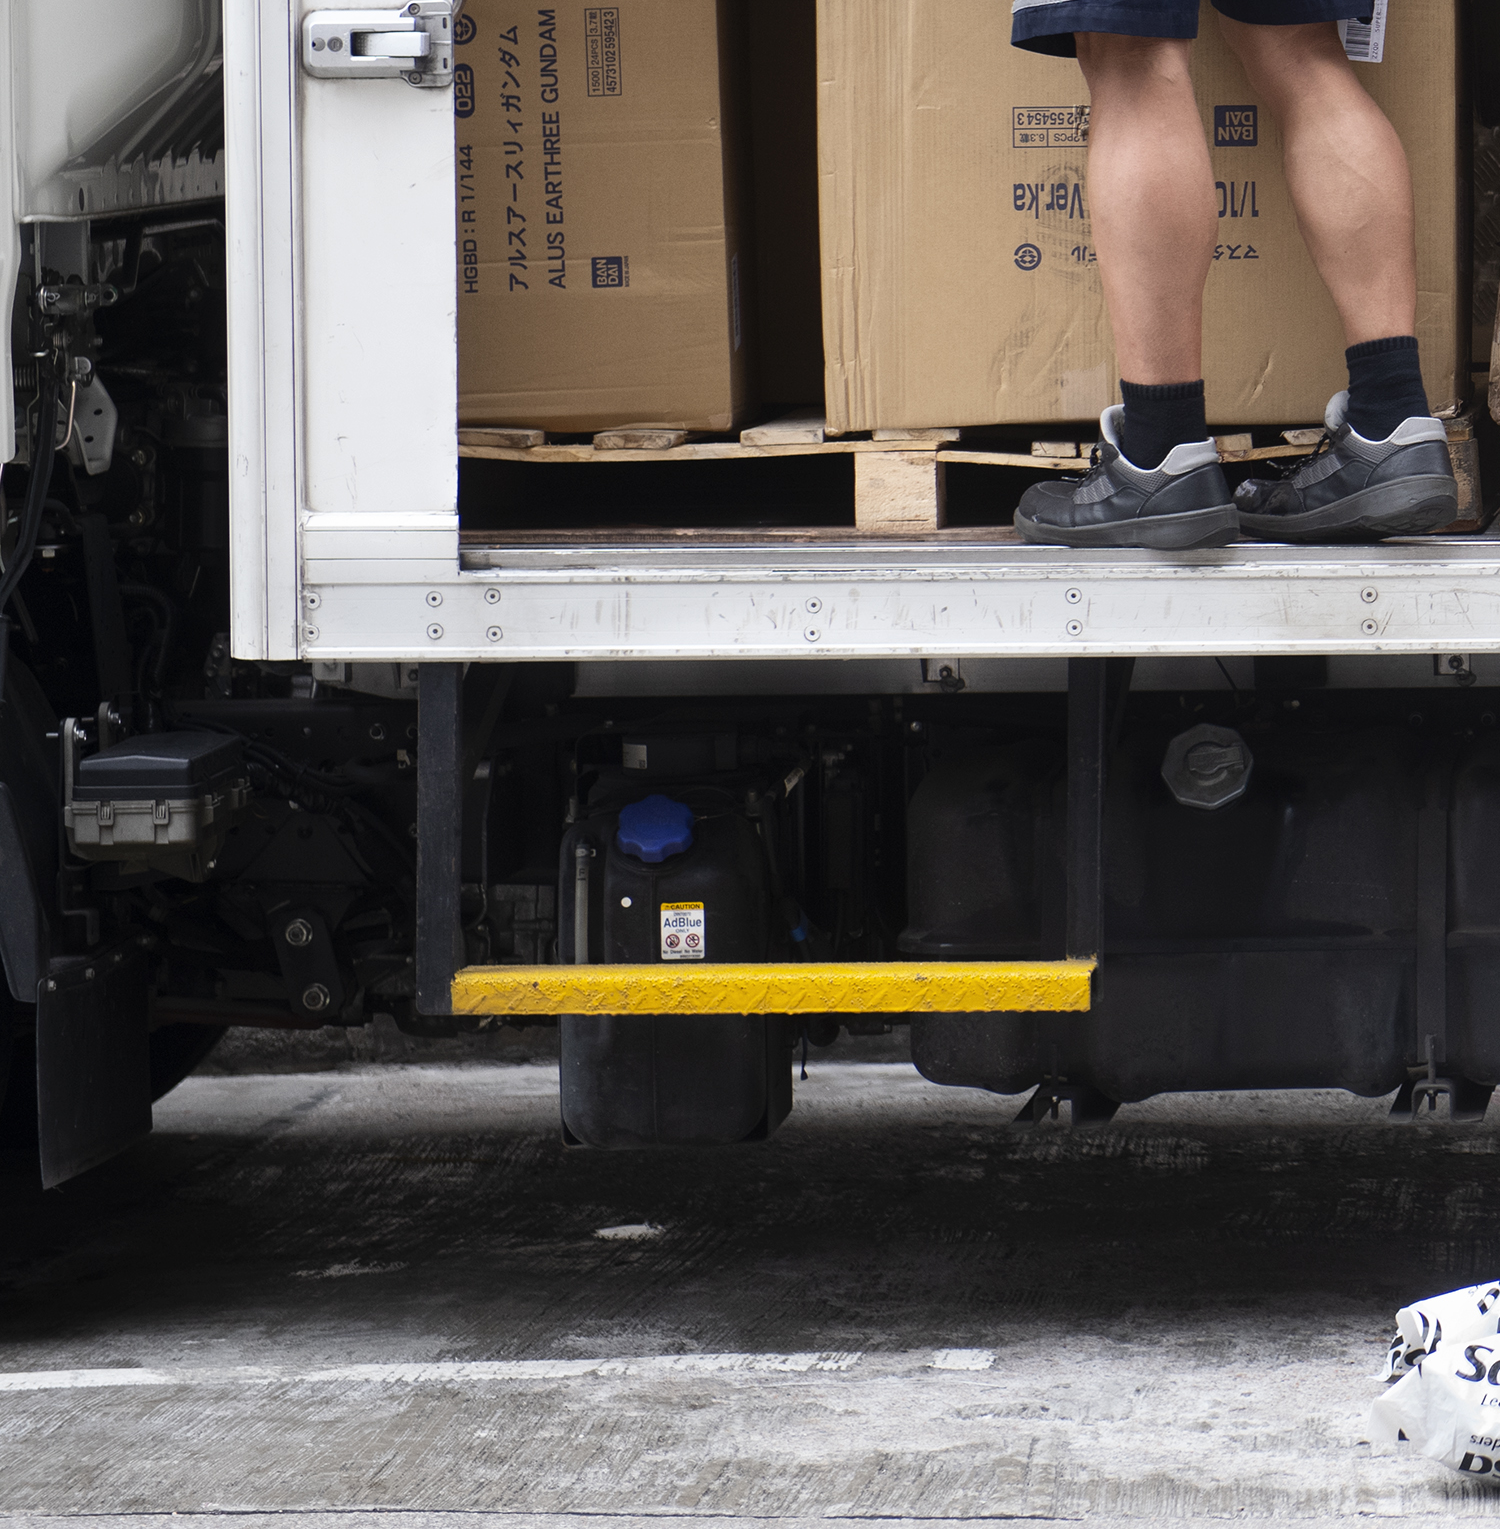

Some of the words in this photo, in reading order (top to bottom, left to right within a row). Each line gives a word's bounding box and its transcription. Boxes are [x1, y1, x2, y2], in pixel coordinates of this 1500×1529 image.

[537, 9, 560, 104] GUNDAM
[1225, 111, 1254, 126] DAI
[1217, 126, 1254, 141] BAN
[541, 110, 565, 225] EARTHREE
[1012, 182, 1085, 220] Ver.ka
[546, 231, 567, 289] ALUS
[596, 258, 607, 286] BAN
[607, 264, 619, 285] DAI
[663, 917, 702, 928] AdBlue
